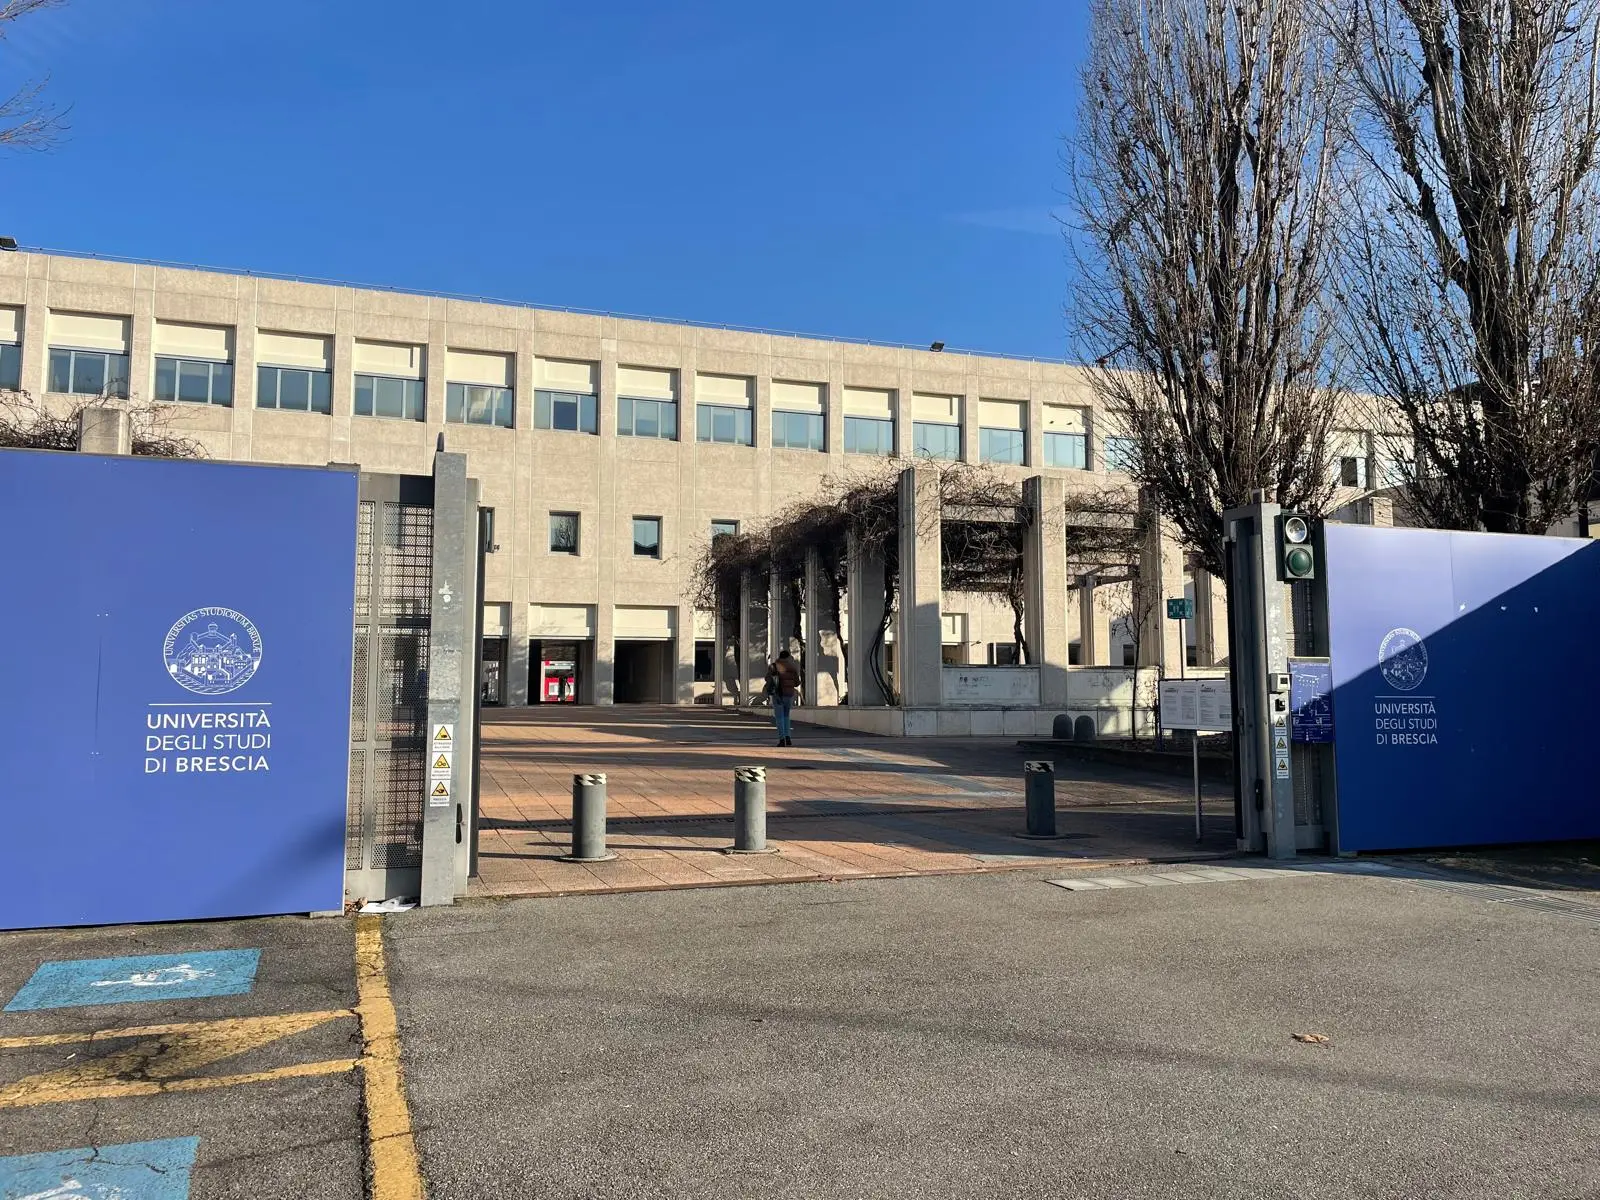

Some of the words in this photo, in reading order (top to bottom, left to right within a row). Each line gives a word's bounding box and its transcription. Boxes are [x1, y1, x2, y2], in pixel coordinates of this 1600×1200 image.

[165, 612, 198, 656] UNIVERSITAS
[200, 608, 249, 628] STUDIORUM
[1374, 701, 1436, 714] UNIVERSITÀ
[147, 709, 271, 729] UNIVERSITÀ
[1375, 718, 1406, 730] DEGLI
[1408, 718, 1437, 730] STUDI
[146, 734, 206, 751] DEGLI
[213, 734, 271, 750] STUDI
[1376, 733, 1388, 745] DI
[1391, 733, 1438, 745] BRESCIA
[145, 757, 167, 773] DI
[176, 756, 270, 773] BRESCIA
